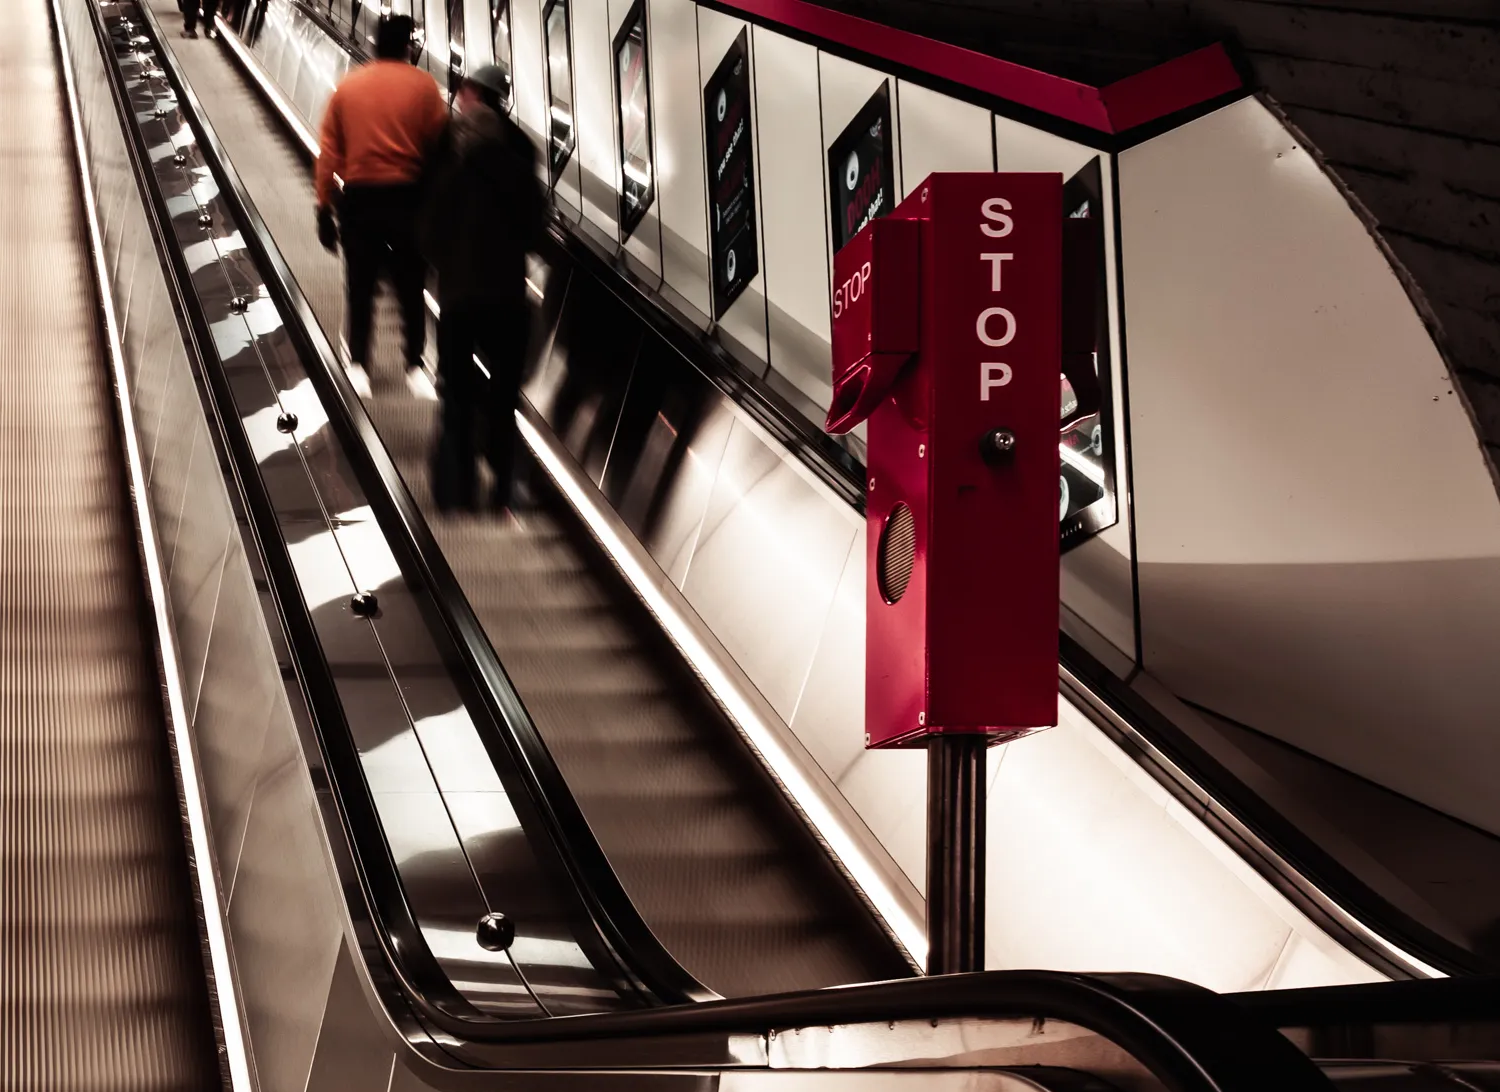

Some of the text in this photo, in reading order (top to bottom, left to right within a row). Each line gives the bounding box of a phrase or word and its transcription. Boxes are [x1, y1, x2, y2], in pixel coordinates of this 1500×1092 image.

[847, 156, 881, 234] DOOH
[834, 261, 872, 319] STOP
[976, 197, 1017, 401] STOP
